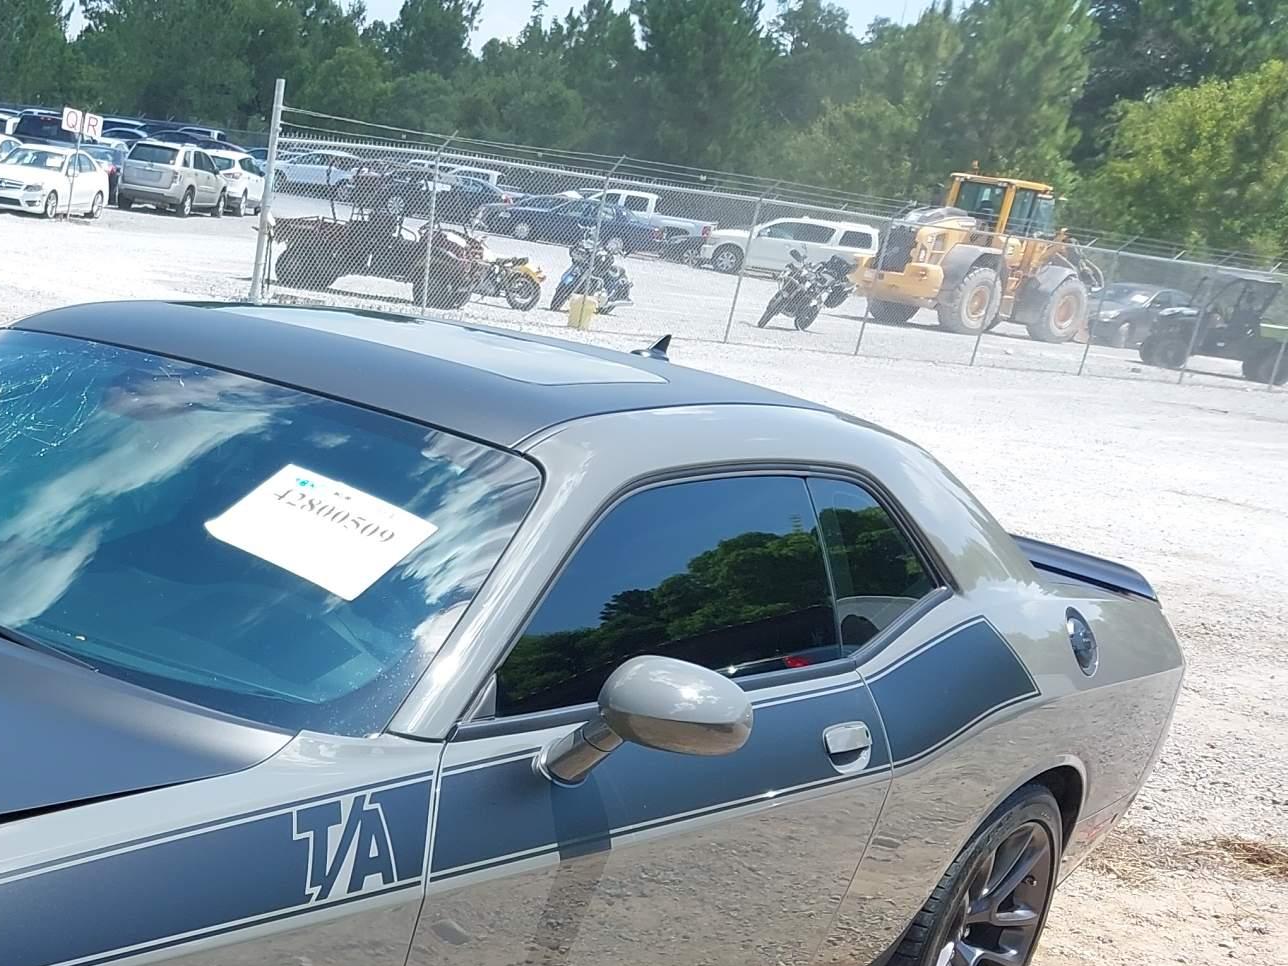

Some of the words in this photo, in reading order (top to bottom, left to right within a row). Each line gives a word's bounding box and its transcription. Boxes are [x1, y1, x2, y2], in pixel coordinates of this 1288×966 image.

[66, 110, 78, 130] Q
[86, 116, 99, 136] R
[273, 488, 395, 543] 42800509
